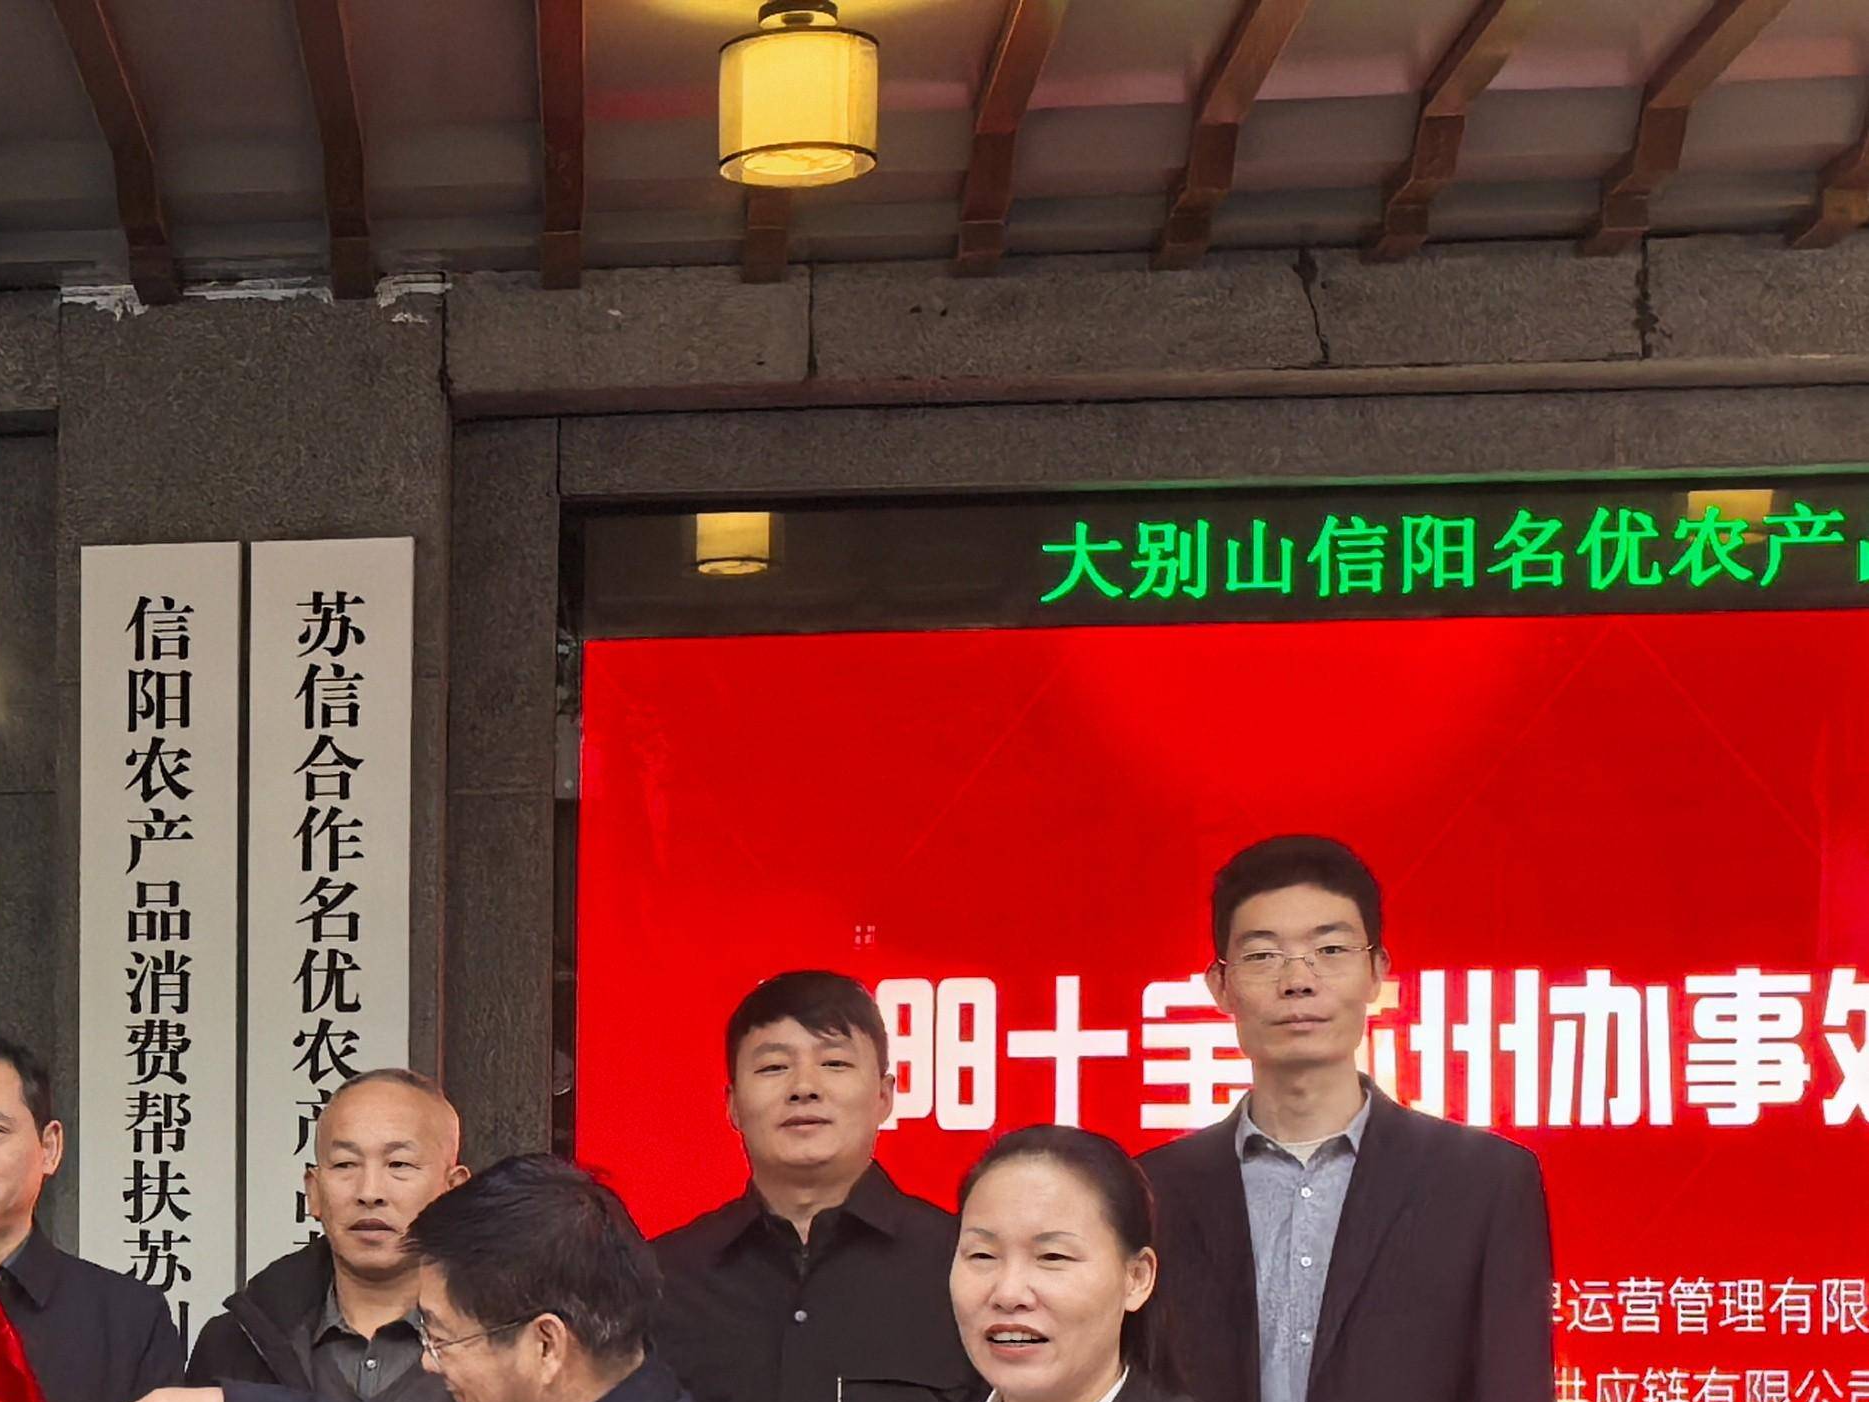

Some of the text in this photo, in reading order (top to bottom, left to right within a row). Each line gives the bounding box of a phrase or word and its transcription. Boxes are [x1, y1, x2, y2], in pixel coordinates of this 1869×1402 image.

[1040, 501, 1869, 603] 大别山信阳名优农产
[122, 595, 195, 1370] 信阳农产品消费帮扶苏
[292, 589, 366, 1248] 苏信合作名优农
